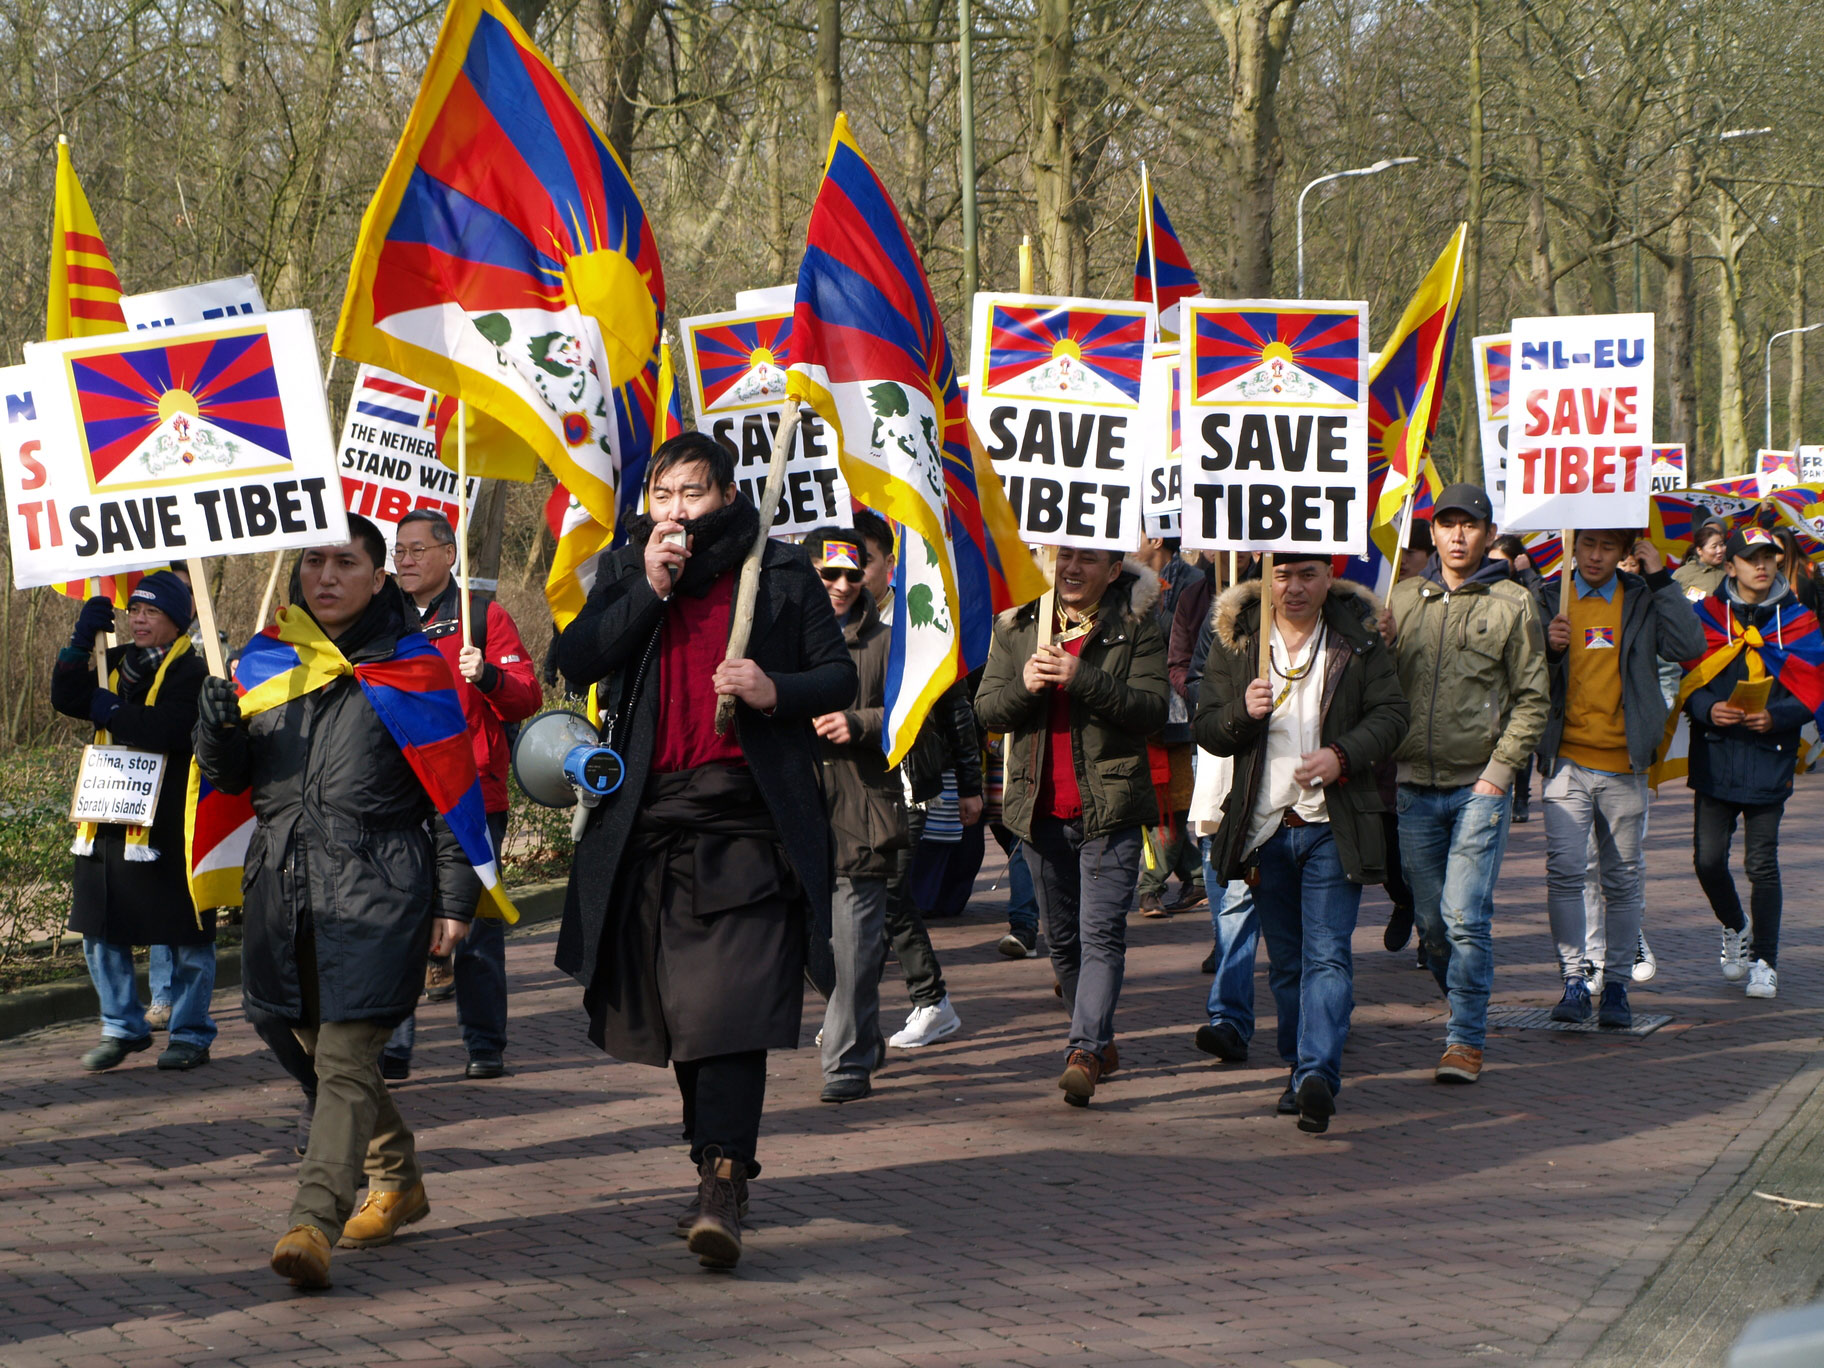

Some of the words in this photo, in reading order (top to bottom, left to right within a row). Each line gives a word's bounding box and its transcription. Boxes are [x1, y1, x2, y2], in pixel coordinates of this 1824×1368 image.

[1521, 338, 1646, 371] NL-EU
[1524, 386, 1638, 438] SAVE
[350, 423, 378, 444] THE
[379, 431, 437, 460] NETHER
[985, 406, 1128, 470] SAVE
[1200, 413, 1348, 473] SAVE
[341, 447, 412, 482] STAND
[1517, 445, 1643, 495] TIBET
[1151, 465, 1180, 504] SA
[1651, 476, 1681, 492] AVE
[69, 495, 187, 558] SAVE
[193, 477, 328, 542] TIBET
[1193, 483, 1356, 542] TIBET
[87, 753, 124, 771] China,
[128, 755, 157, 774] stop
[83, 776, 153, 796] claiming
[77, 796, 110, 817] Spratly
[111, 798, 147, 815] Islands
